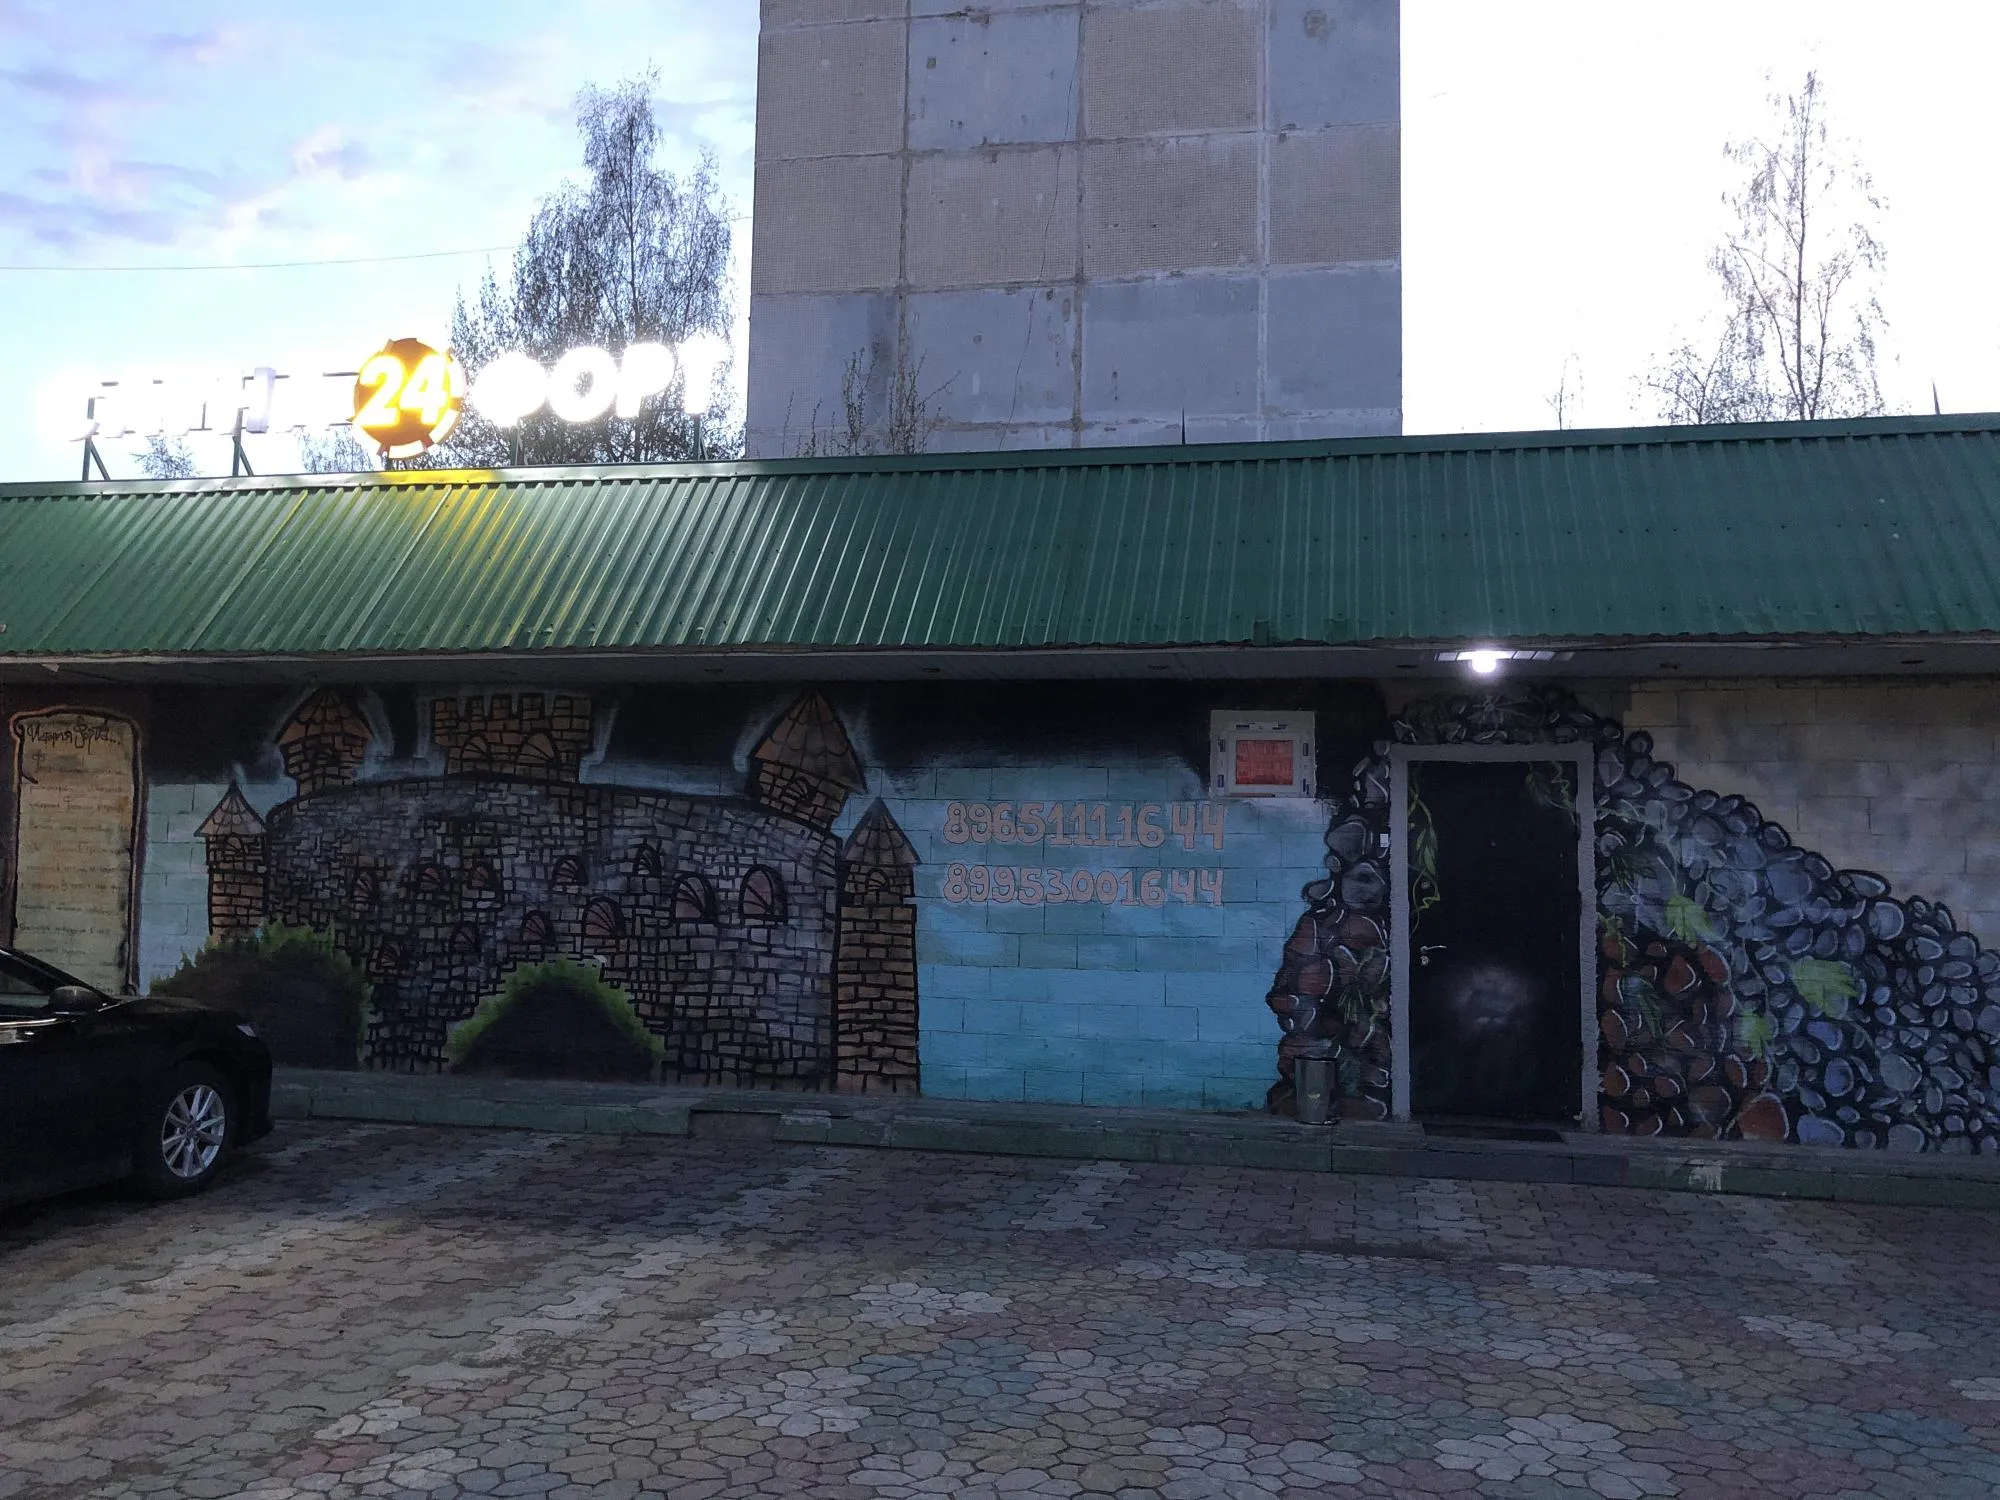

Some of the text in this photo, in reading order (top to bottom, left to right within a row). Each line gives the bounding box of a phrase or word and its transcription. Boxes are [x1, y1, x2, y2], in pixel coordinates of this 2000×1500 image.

[354, 351, 451, 428] 24
[471, 331, 733, 429] ФОРТ
[943, 802, 1226, 849] 89651111644
[943, 863, 1224, 906] 89953001644
